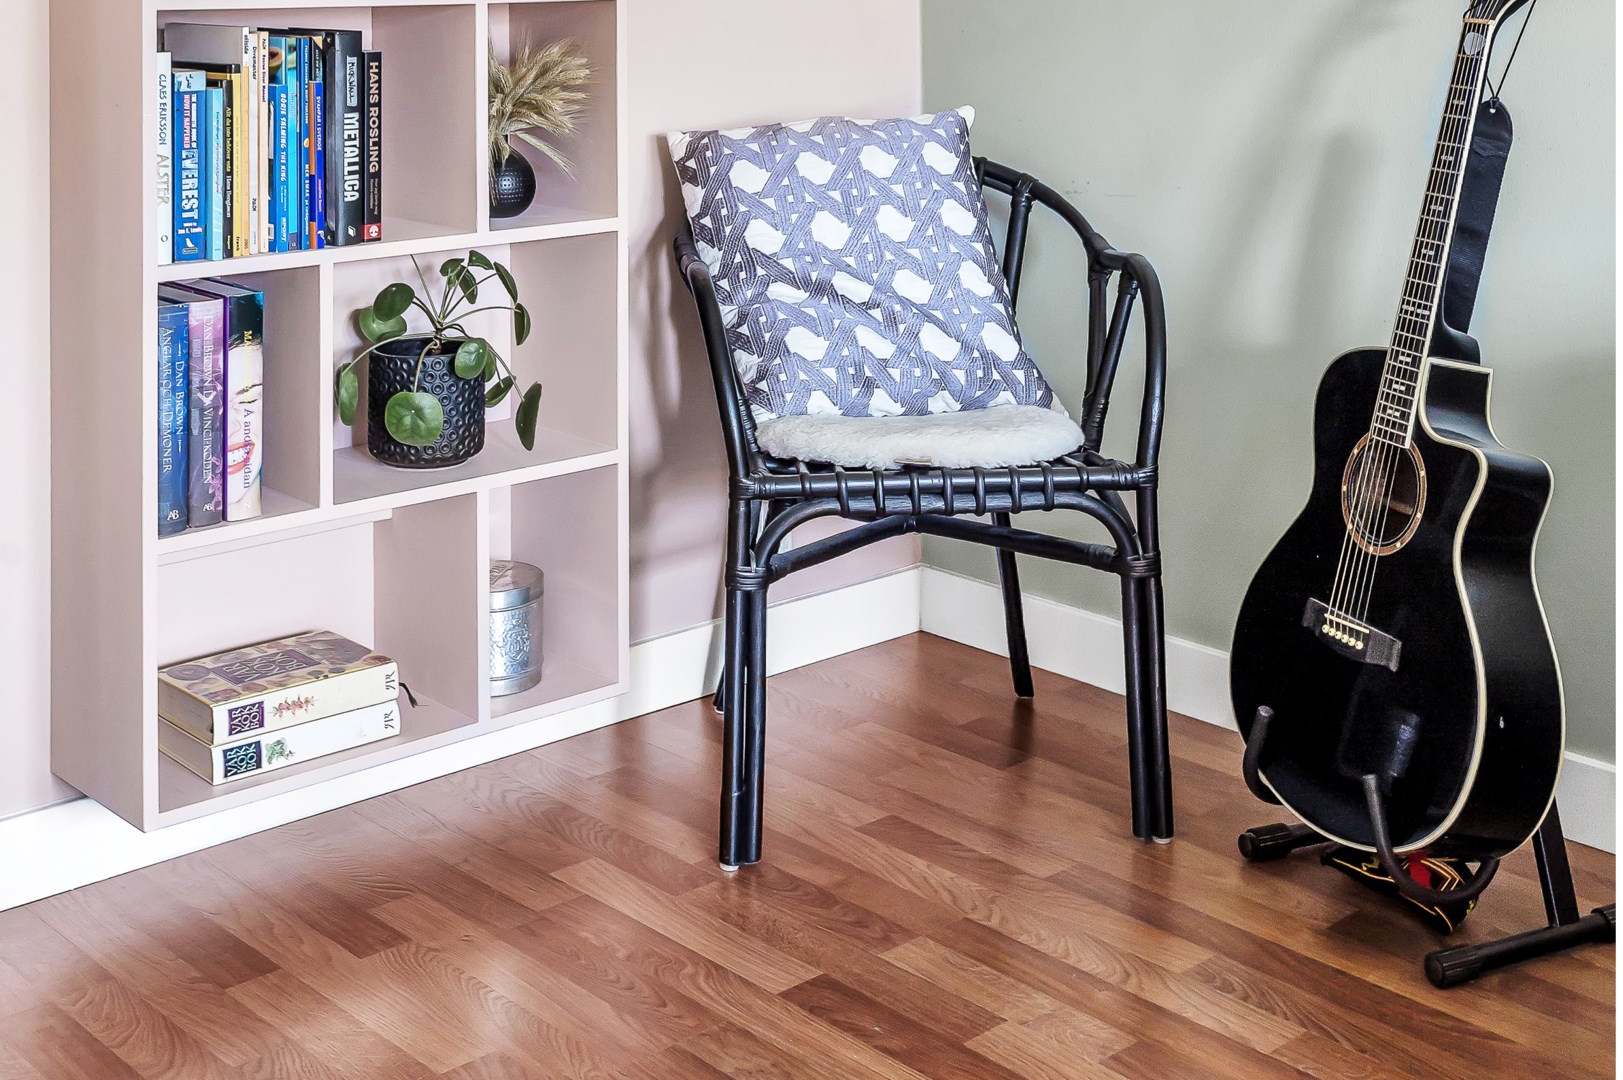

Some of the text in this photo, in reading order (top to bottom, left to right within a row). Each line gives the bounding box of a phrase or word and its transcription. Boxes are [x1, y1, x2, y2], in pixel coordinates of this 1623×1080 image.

[369, 61, 380, 174] HANS ROSLING
[156, 73, 170, 208] CLAES ERIKSSON ALSTER
[343, 111, 360, 203] METALLICA
[181, 148, 199, 220] EVEREST
[203, 315, 215, 341] DAN
[203, 343, 215, 386] BROWN
[161, 379, 172, 409] OCH
[174, 360, 186, 435] DAN BROWN
[243, 407, 254, 419] Å
[161, 409, 173, 473] DEMONER
[202, 407, 215, 484] VINCI-KODEN
[230, 706, 243, 735] VÅR
[241, 705, 252, 731] KOK
[250, 703, 260, 729] BOK
[225, 748, 238, 777] VÅR
[236, 746, 248, 773] KOK
[246, 743, 258, 770] BOK
